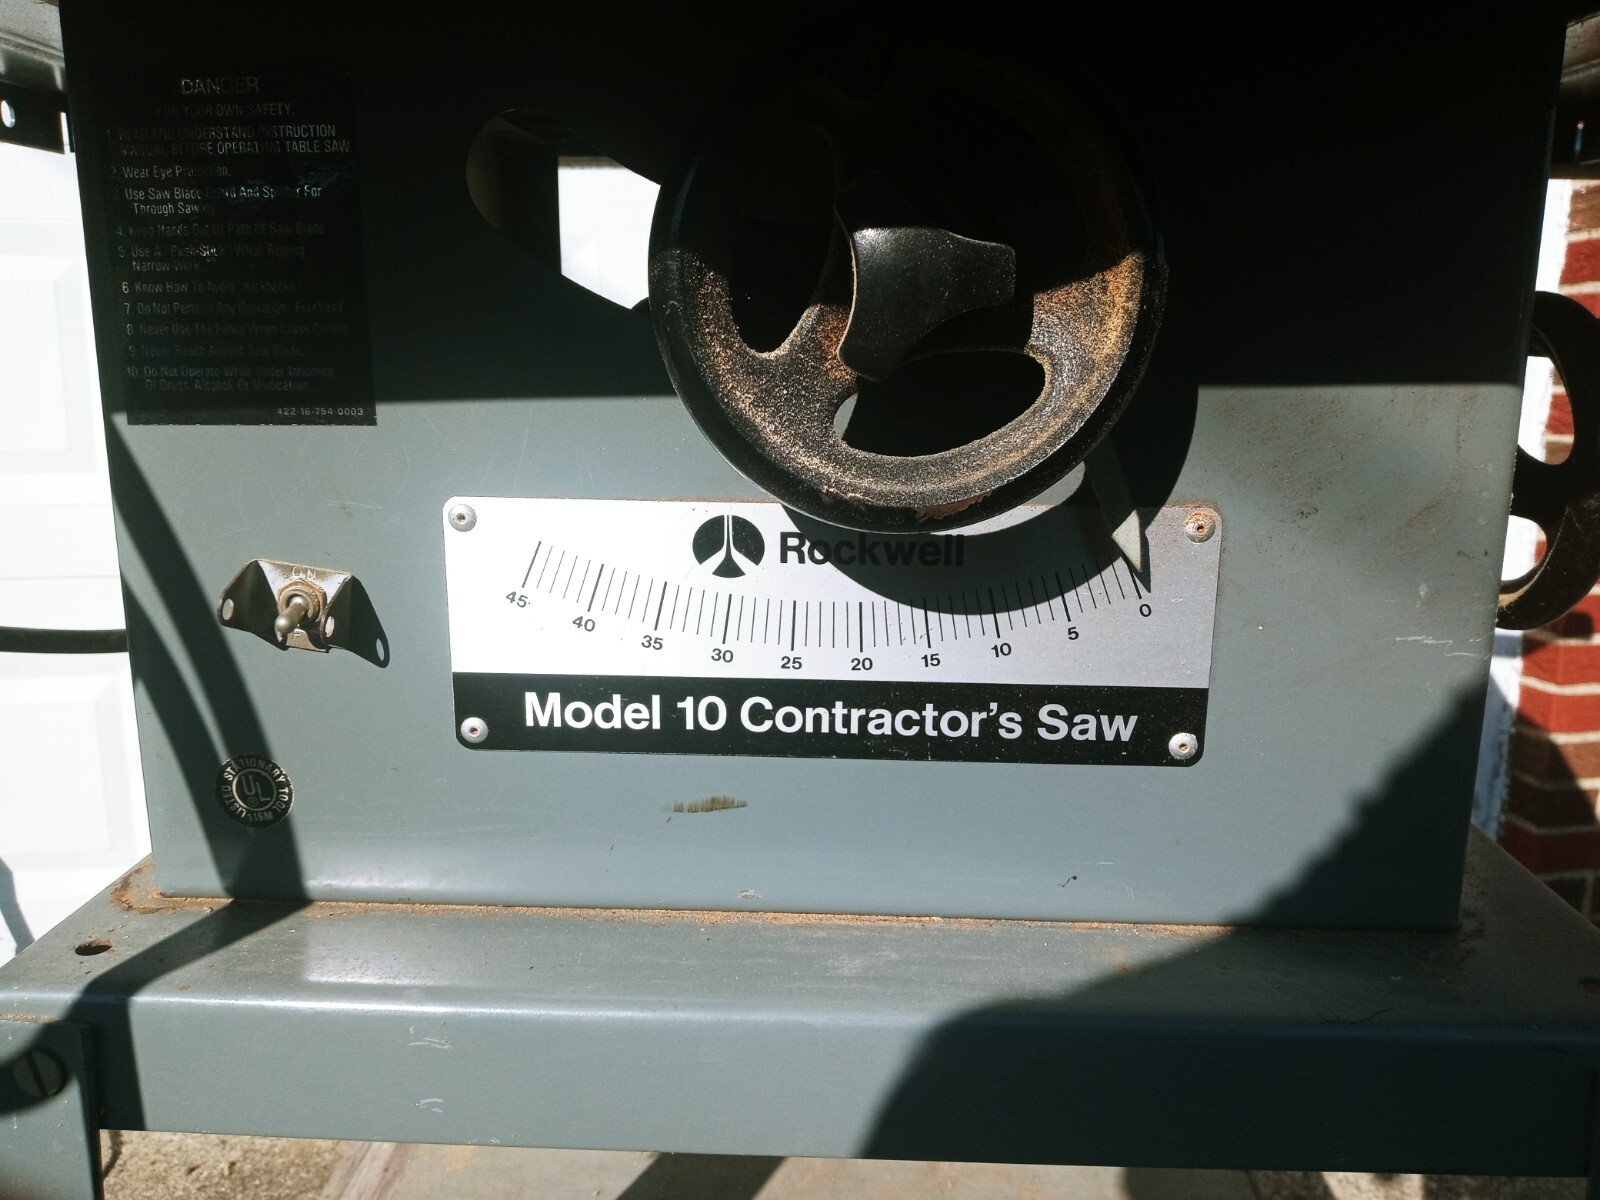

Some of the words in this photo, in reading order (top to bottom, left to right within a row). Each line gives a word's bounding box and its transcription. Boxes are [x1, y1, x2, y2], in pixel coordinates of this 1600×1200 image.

[181, 76, 259, 95] DANGER
[183, 104, 212, 117] YOUR
[216, 103, 243, 116] OWN
[178, 126, 254, 140] UNDERSTAND
[258, 124, 336, 138] INSTRUCTION
[171, 141, 214, 155] BEFORE
[217, 140, 281, 154] OPERATING
[284, 140, 320, 153] TABLE
[122, 166, 149, 178] Wear
[152, 165, 173, 180] Eye
[124, 188, 145, 200] Use
[148, 187, 170, 200] Saw
[240, 186, 260, 198] And
[303, 184, 322, 197] For
[133, 203, 174, 216] Through
[157, 224, 189, 237] Hands
[269, 222, 293, 235] Saw
[131, 245, 150, 257] Use
[132, 260, 170, 272] Narrow
[135, 281, 162, 293] Know
[166, 281, 188, 293] How
[137, 302, 151, 314] Do
[139, 323, 169, 336] Never
[171, 323, 191, 336] Use
[779, 531, 965, 567] Rockwell
[505, 591, 528, 608] 45
[1139, 604, 1152, 618] 0
[572, 616, 596, 632] 40
[1067, 626, 1079, 640] 5
[641, 635, 664, 651] 35
[991, 643, 1012, 658] 10
[711, 648, 734, 663] 30
[921, 653, 941, 668] 15
[780, 656, 803, 671] 25
[851, 658, 873, 671] 20
[524, 692, 661, 730] Model
[676, 695, 727, 731] 10
[740, 696, 1022, 740] Contractor's
[1037, 703, 1139, 742] Saw
[223, 758, 287, 781] STATIONARY
[241, 775, 271, 802] UL
[221, 785, 247, 818] LISTED
[272, 786, 289, 812] TOOL
